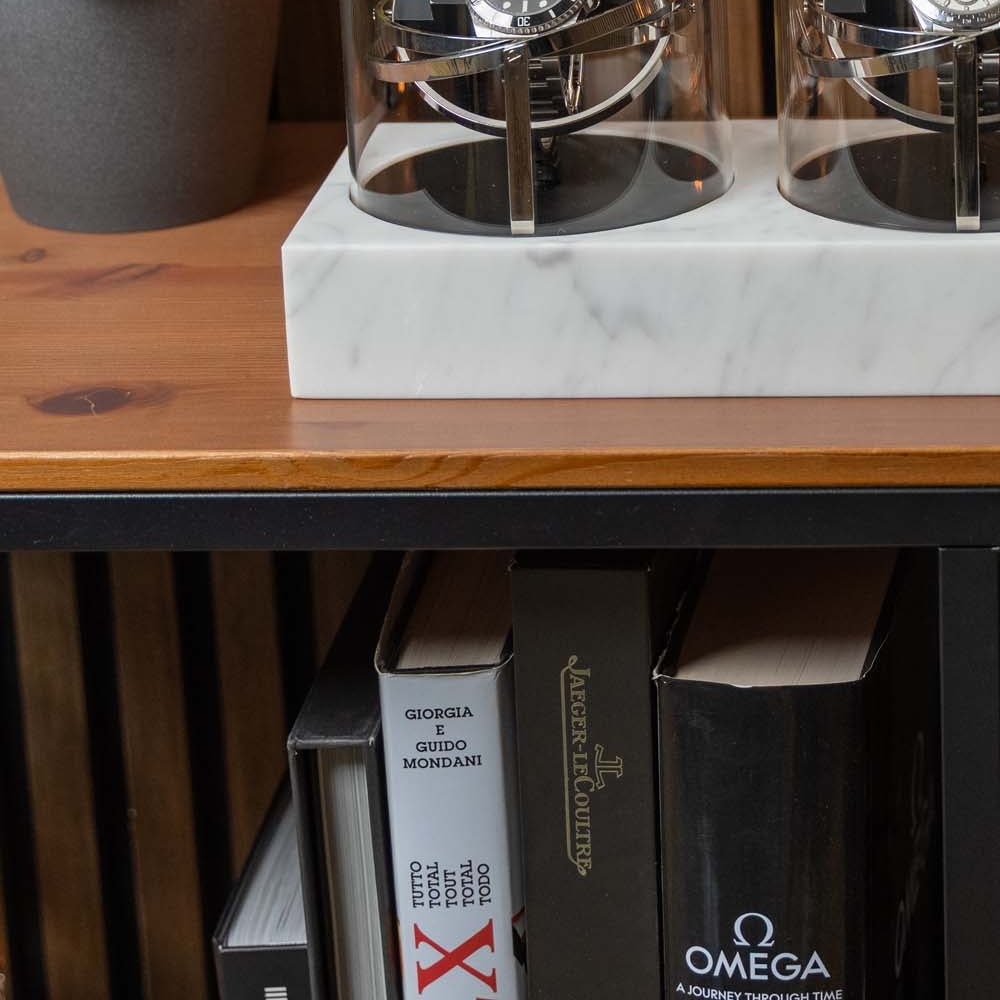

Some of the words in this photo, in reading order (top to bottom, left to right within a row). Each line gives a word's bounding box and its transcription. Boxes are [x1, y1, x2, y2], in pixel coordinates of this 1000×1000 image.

[517, 16, 531, 27] 30
[405, 706, 474, 720] GIORGIA
[435, 724, 445, 735] E
[402, 754, 482, 769] MONDANI
[415, 740, 467, 752] GUIDO
[410, 861, 424, 908] TUTTO
[426, 861, 441, 909] TOTAL
[443, 869, 458, 908] TOUT
[460, 859, 475, 907] TOTAL
[477, 863, 491, 906] TODO
[413, 918, 498, 1000] X
[685, 945, 831, 981] OMEGA
[676, 982, 686, 994] A
[687, 985, 742, 1000] JOURNEY
[744, 991, 809, 1000] THROUGH
[812, 989, 843, 1000] TIME
